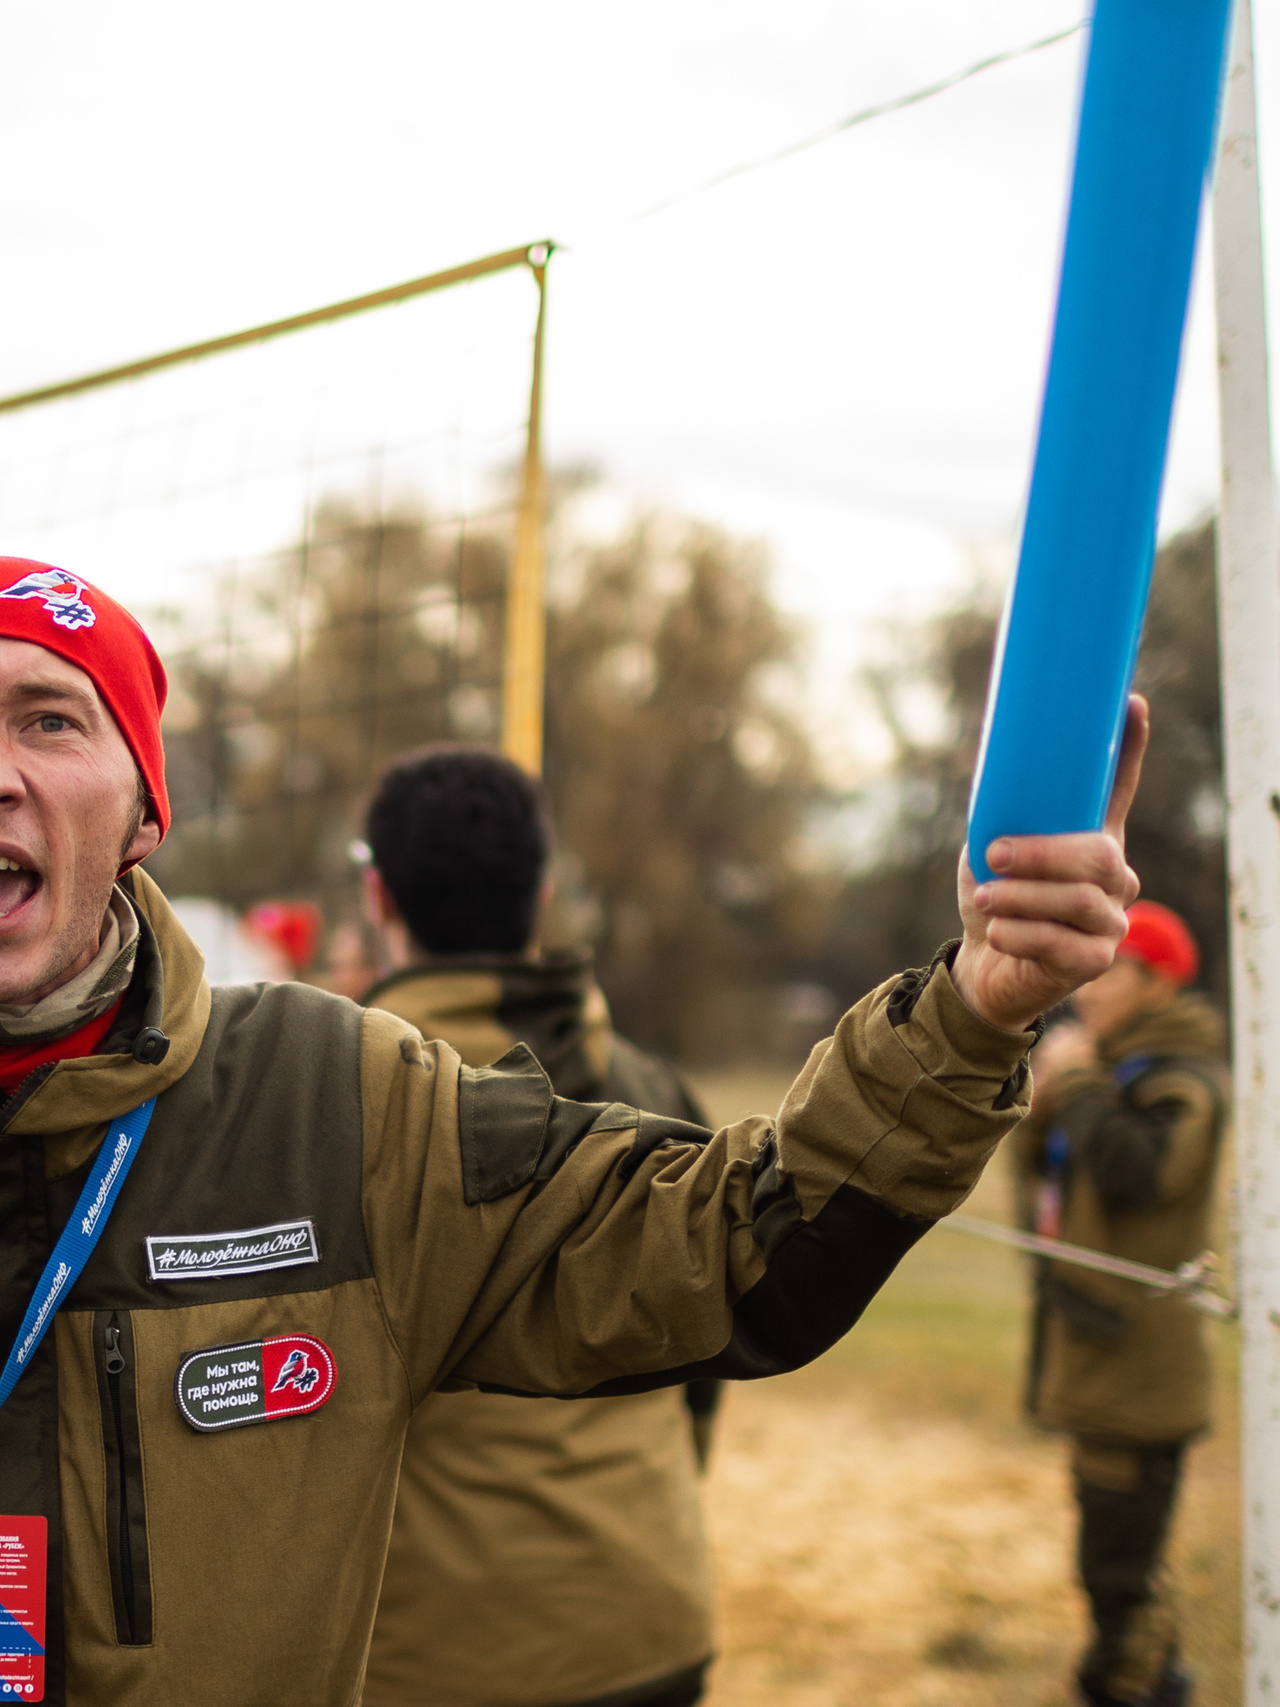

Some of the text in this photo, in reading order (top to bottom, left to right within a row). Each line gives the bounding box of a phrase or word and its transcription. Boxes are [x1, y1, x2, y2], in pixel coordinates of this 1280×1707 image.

[155, 1229, 310, 1271] #МолодёжкаОНФ
[206, 1360, 260, 1379] Мы там,
[187, 1375, 258, 1400] где нужна
[203, 1392, 259, 1412] помощь
